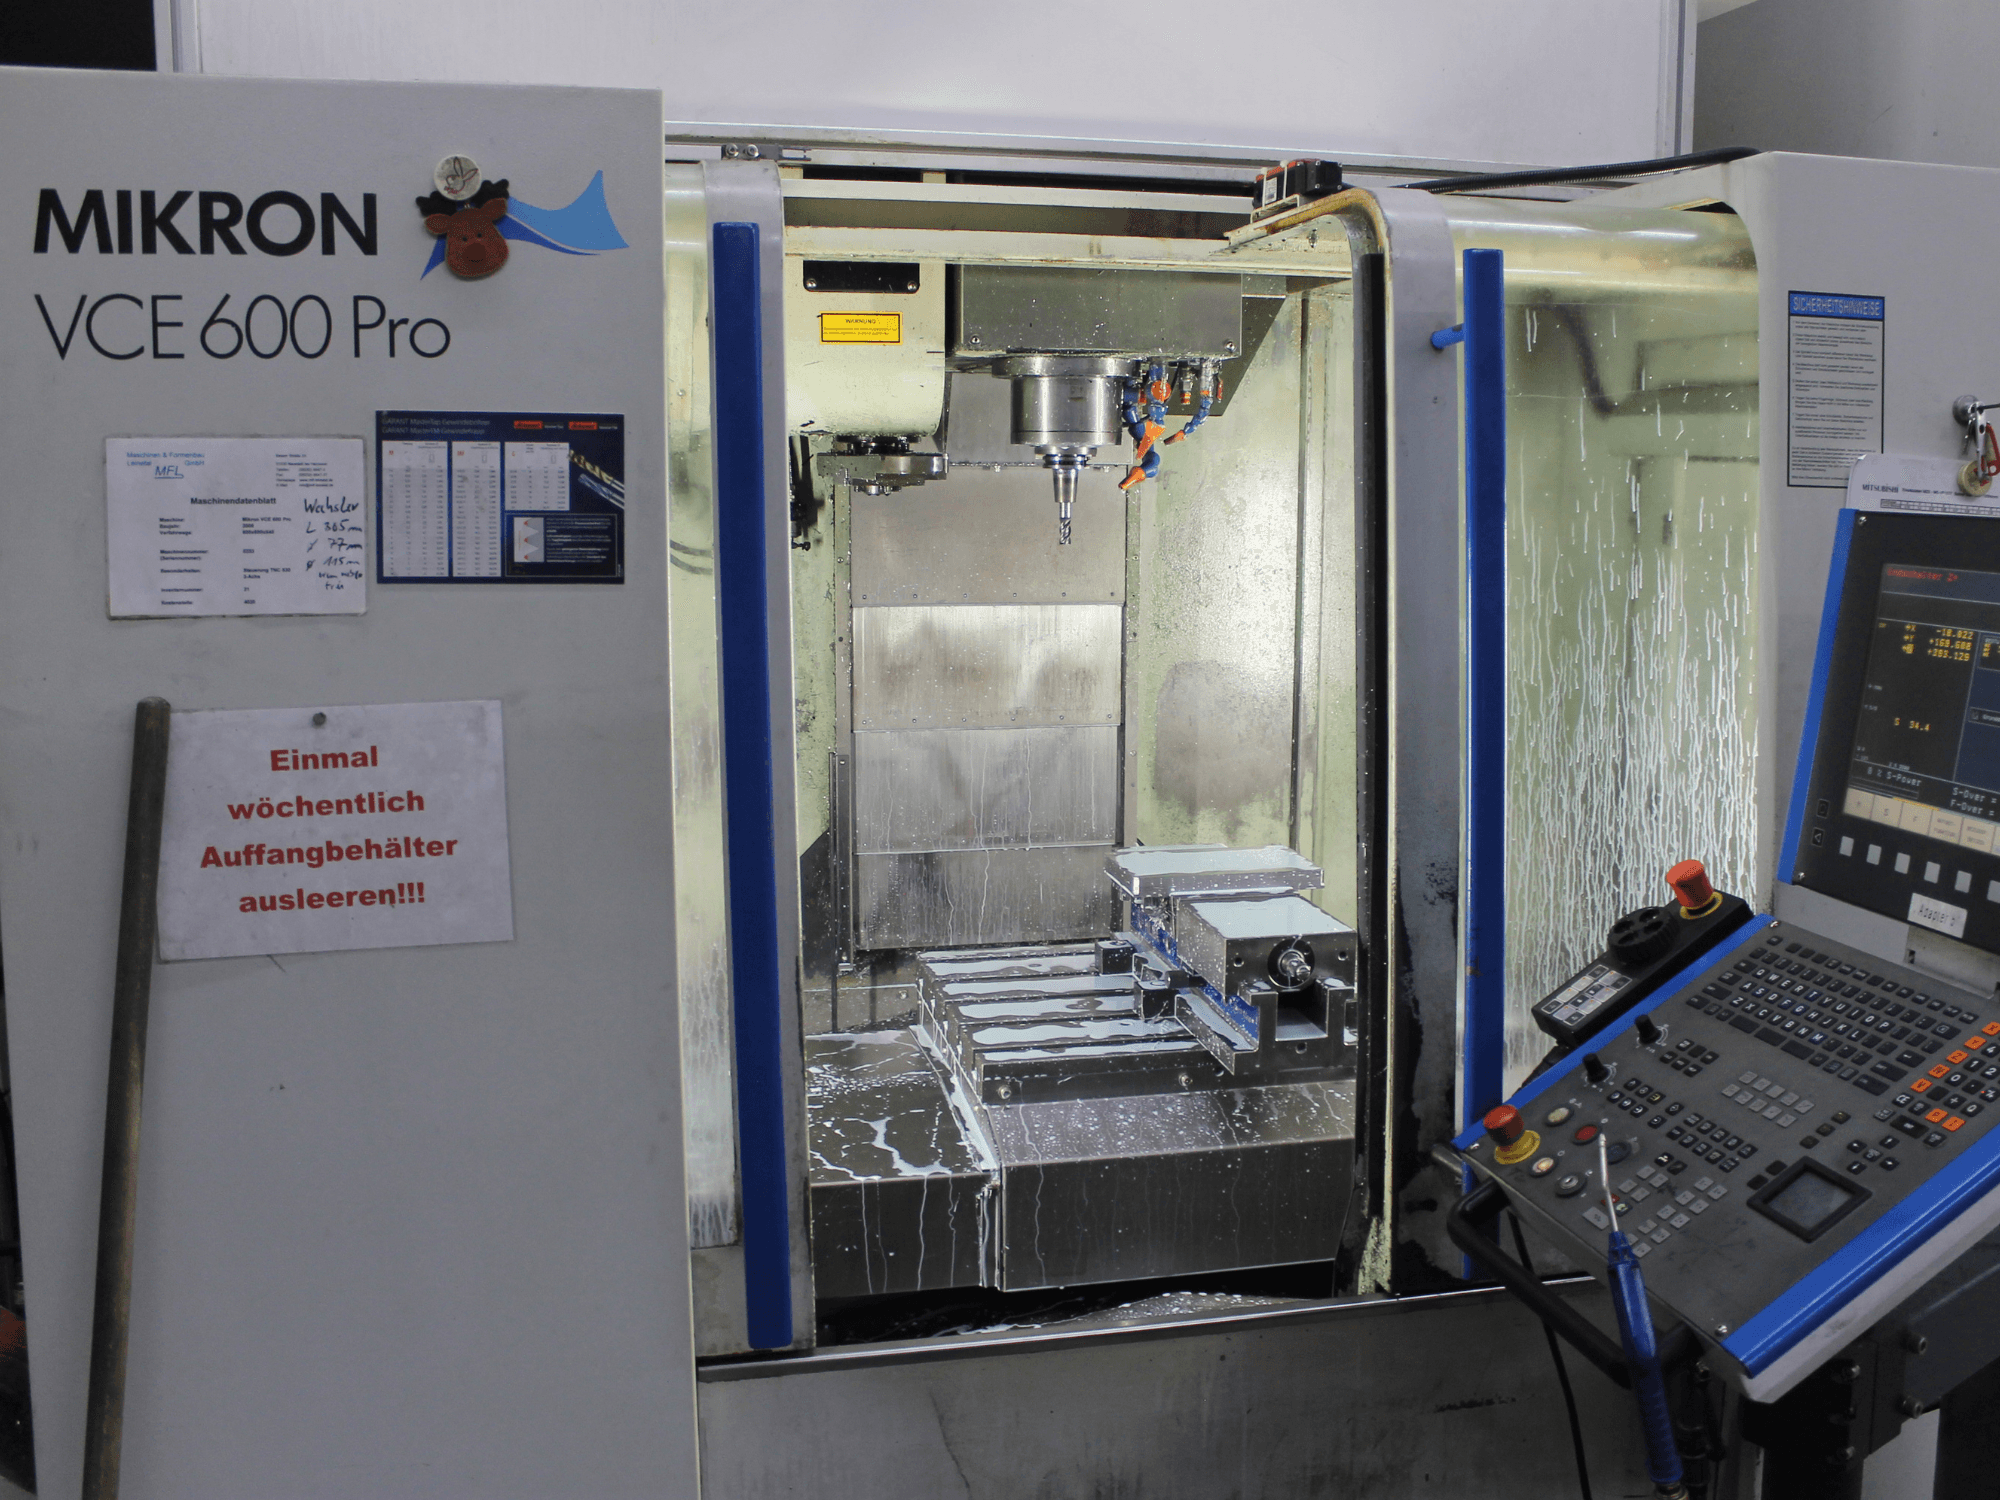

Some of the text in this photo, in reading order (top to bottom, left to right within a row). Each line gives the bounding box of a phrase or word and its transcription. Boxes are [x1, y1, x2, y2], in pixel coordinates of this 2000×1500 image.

[36, 188, 378, 256] MIKRON
[1793, 296, 1880, 316] SICHERHEITSHINWEISE
[34, 292, 451, 360] VCE 600 Pro
[155, 466, 184, 479] MFL
[1862, 484, 1899, 493] MITSUBISHI
[270, 745, 379, 772] Einmal
[228, 790, 425, 820] wöchentlich
[1952, 787, 1985, 802] S-Over
[1950, 799, 1983, 814] F-Over
[200, 836, 458, 869] Auffangbehälter
[239, 882, 426, 913] ausleeren!!!
[1984, 1067, 1997, 1076] 2
